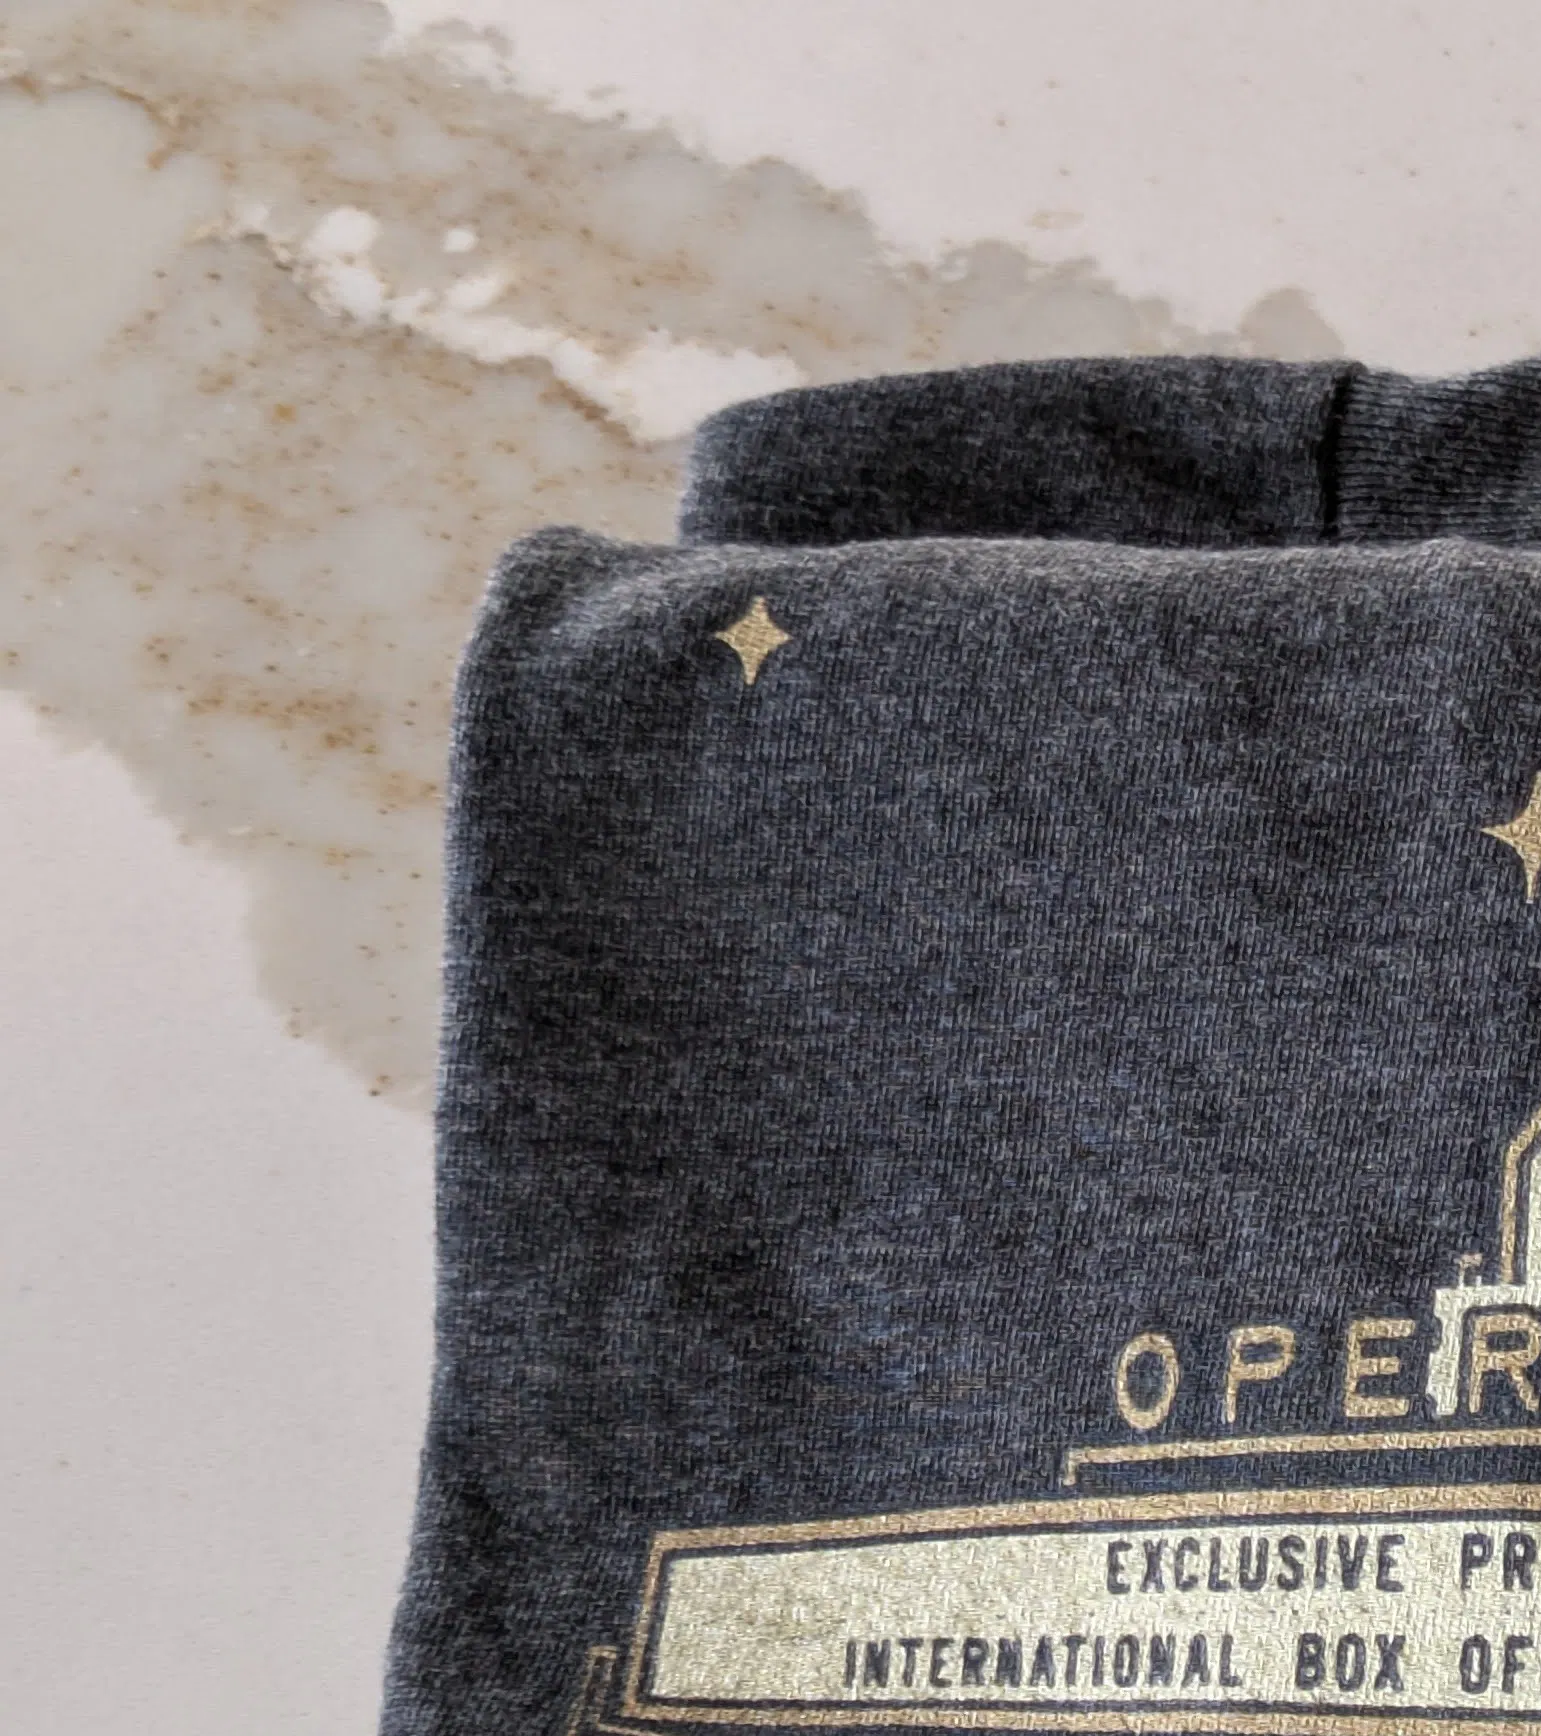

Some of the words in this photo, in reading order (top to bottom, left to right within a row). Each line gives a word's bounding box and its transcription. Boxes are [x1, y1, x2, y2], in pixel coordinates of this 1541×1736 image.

[1104, 1533, 1407, 1597] EXCLUSIVE
[842, 1634, 1244, 1692] INTERNATIONAL
[1295, 1634, 1407, 1694] BOX
